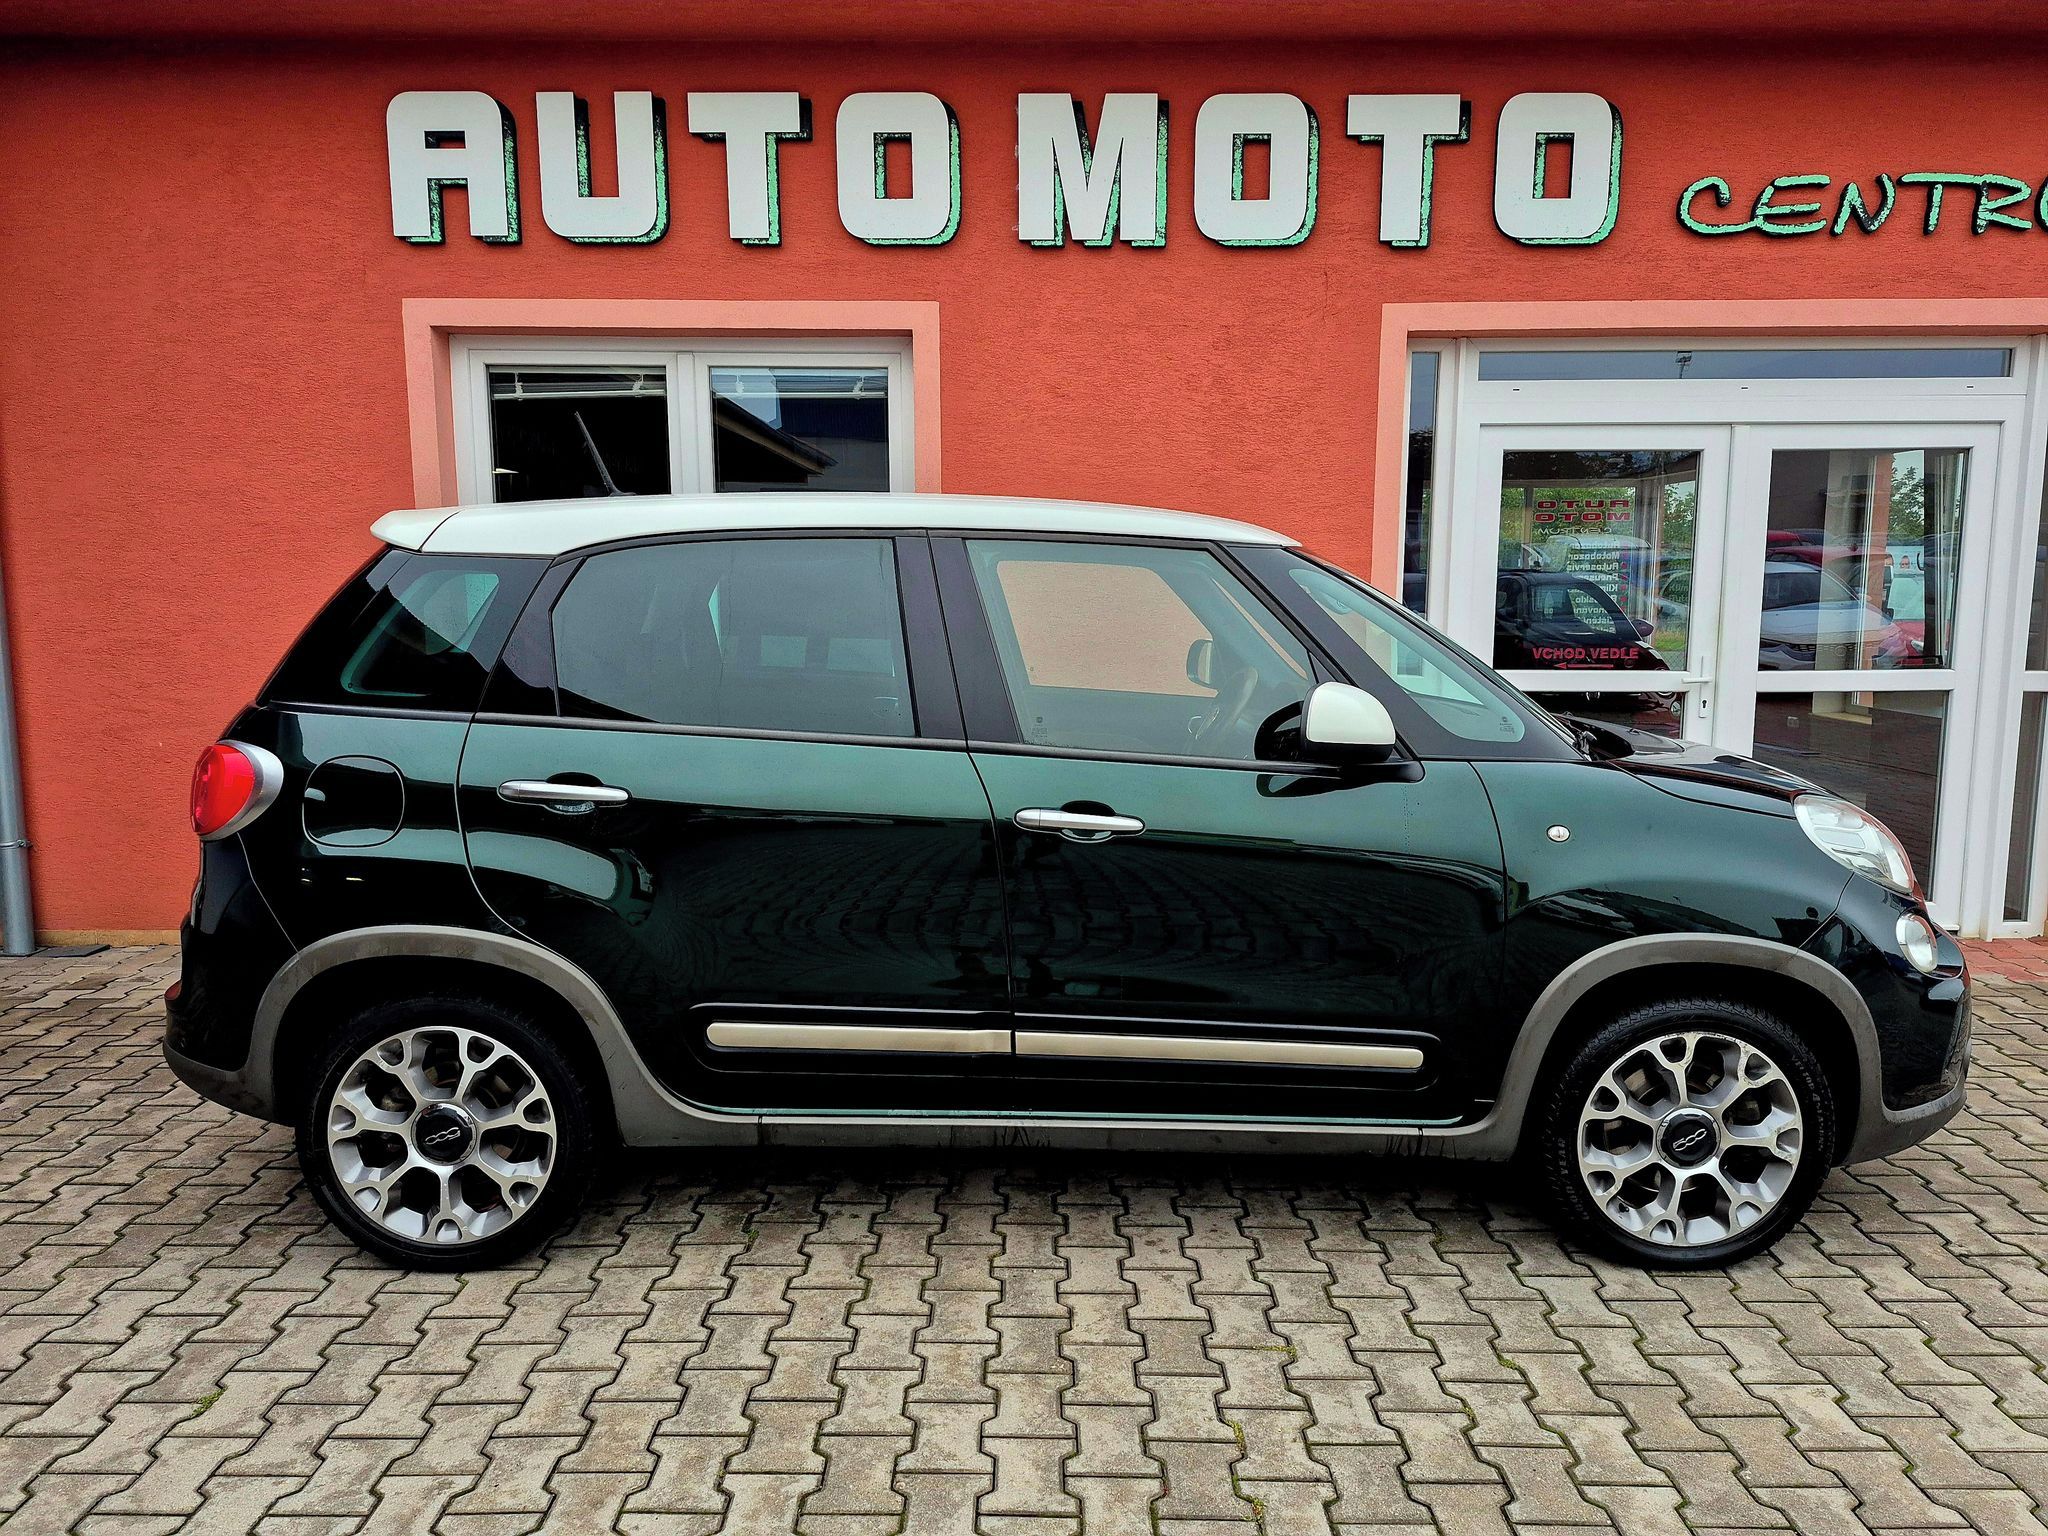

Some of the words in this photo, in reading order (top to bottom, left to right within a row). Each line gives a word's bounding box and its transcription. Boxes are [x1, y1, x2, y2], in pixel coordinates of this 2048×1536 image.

[386, 90, 960, 246] AUTO
[1016, 92, 1623, 247] MOTO
[1676, 172, 2048, 236] CENTR
[1532, 647, 1586, 660] VCHOD
[1590, 647, 1639, 660] VEDLE
